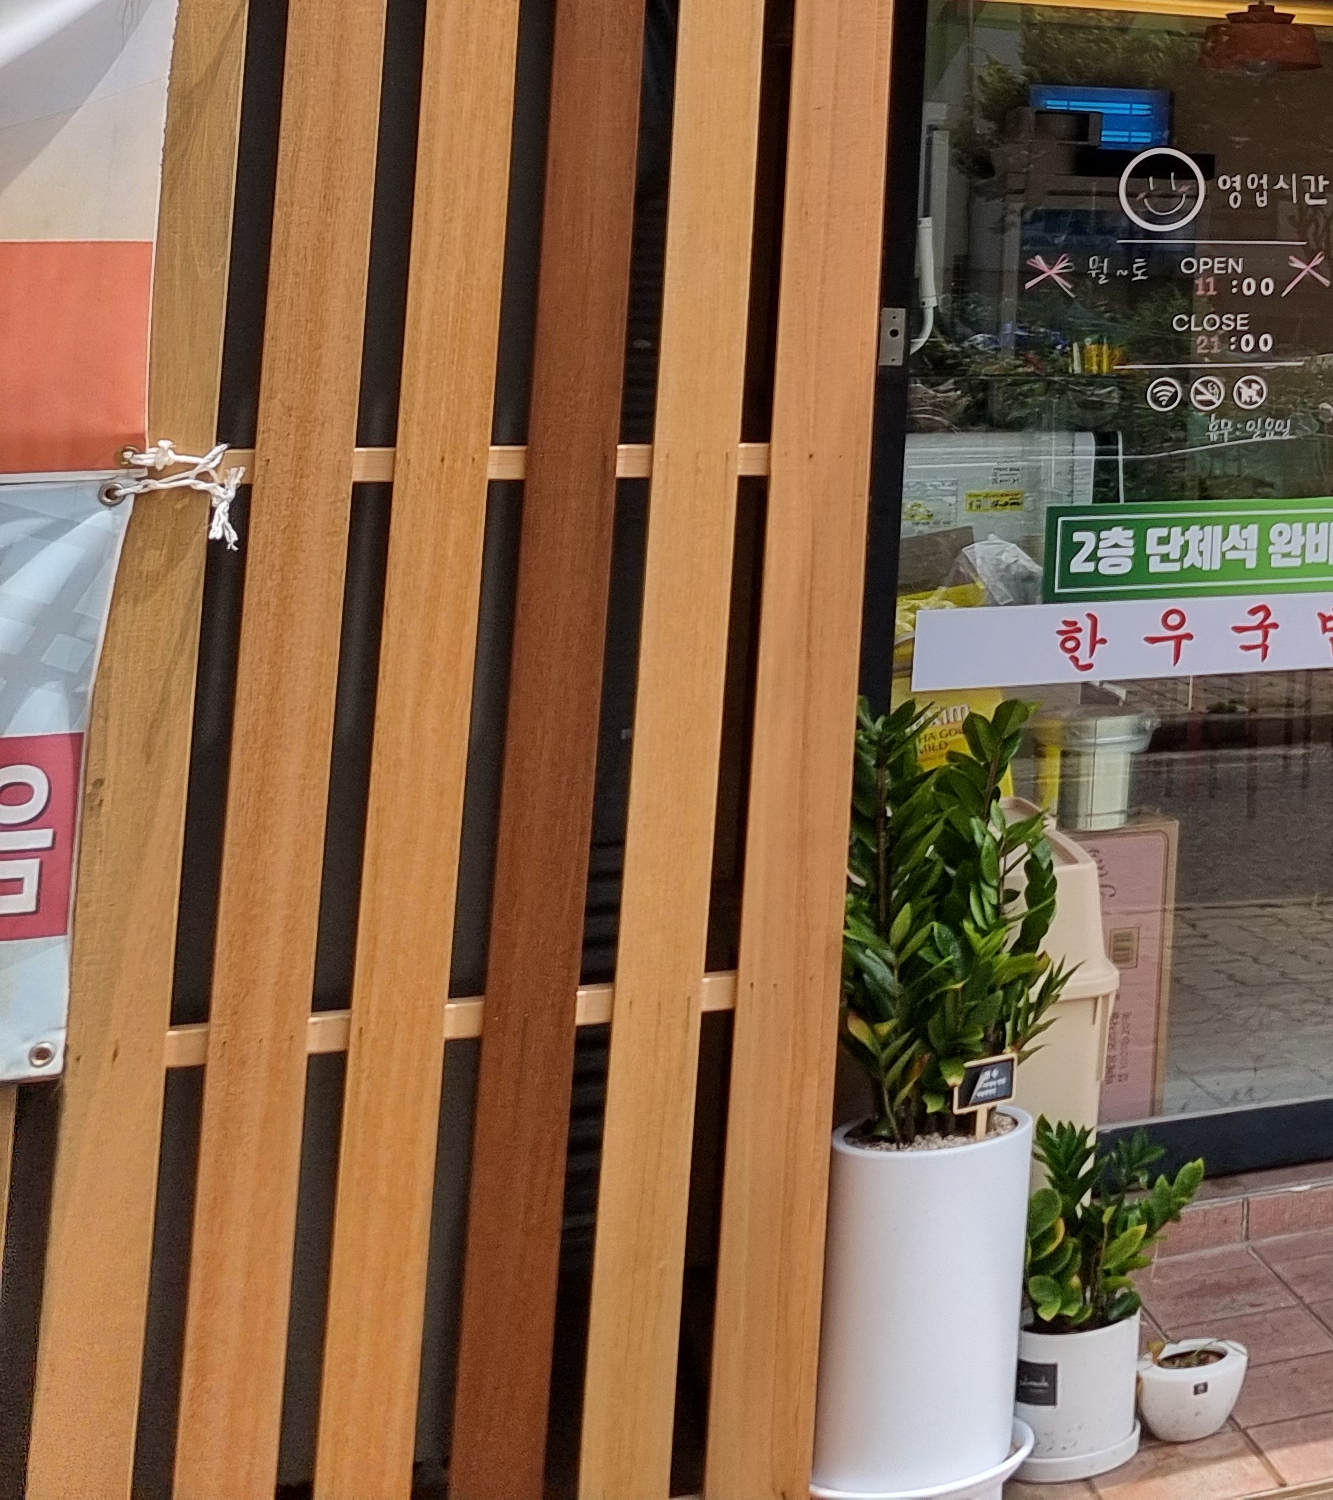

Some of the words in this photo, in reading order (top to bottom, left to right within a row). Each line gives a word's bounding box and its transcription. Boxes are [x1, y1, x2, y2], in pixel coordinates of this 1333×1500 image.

[1217, 173, 1330, 209] 영업시간
[1180, 257, 1244, 275] OPEN
[1172, 313, 1250, 331] CLOSE
[1070, 526, 1135, 575] 2층
[1146, 523, 1259, 572] 단체석
